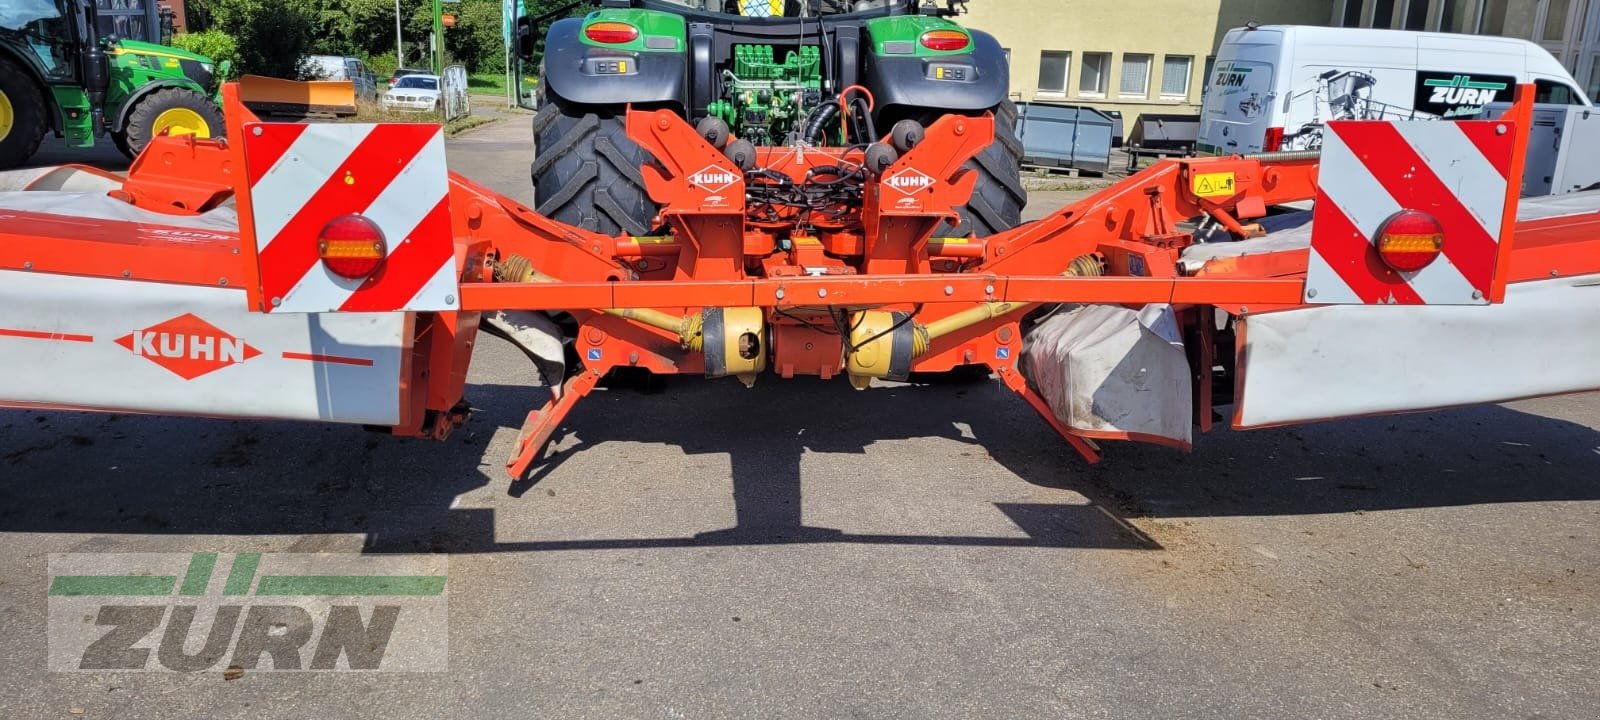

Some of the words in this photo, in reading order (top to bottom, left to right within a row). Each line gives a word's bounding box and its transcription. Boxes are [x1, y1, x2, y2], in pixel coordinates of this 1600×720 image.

[1429, 75, 1497, 105] ZÜRN
[694, 173, 734, 185] KUHN
[891, 175, 929, 187] KUHN
[152, 229, 231, 240] KUHN
[133, 330, 245, 363] KUHN
